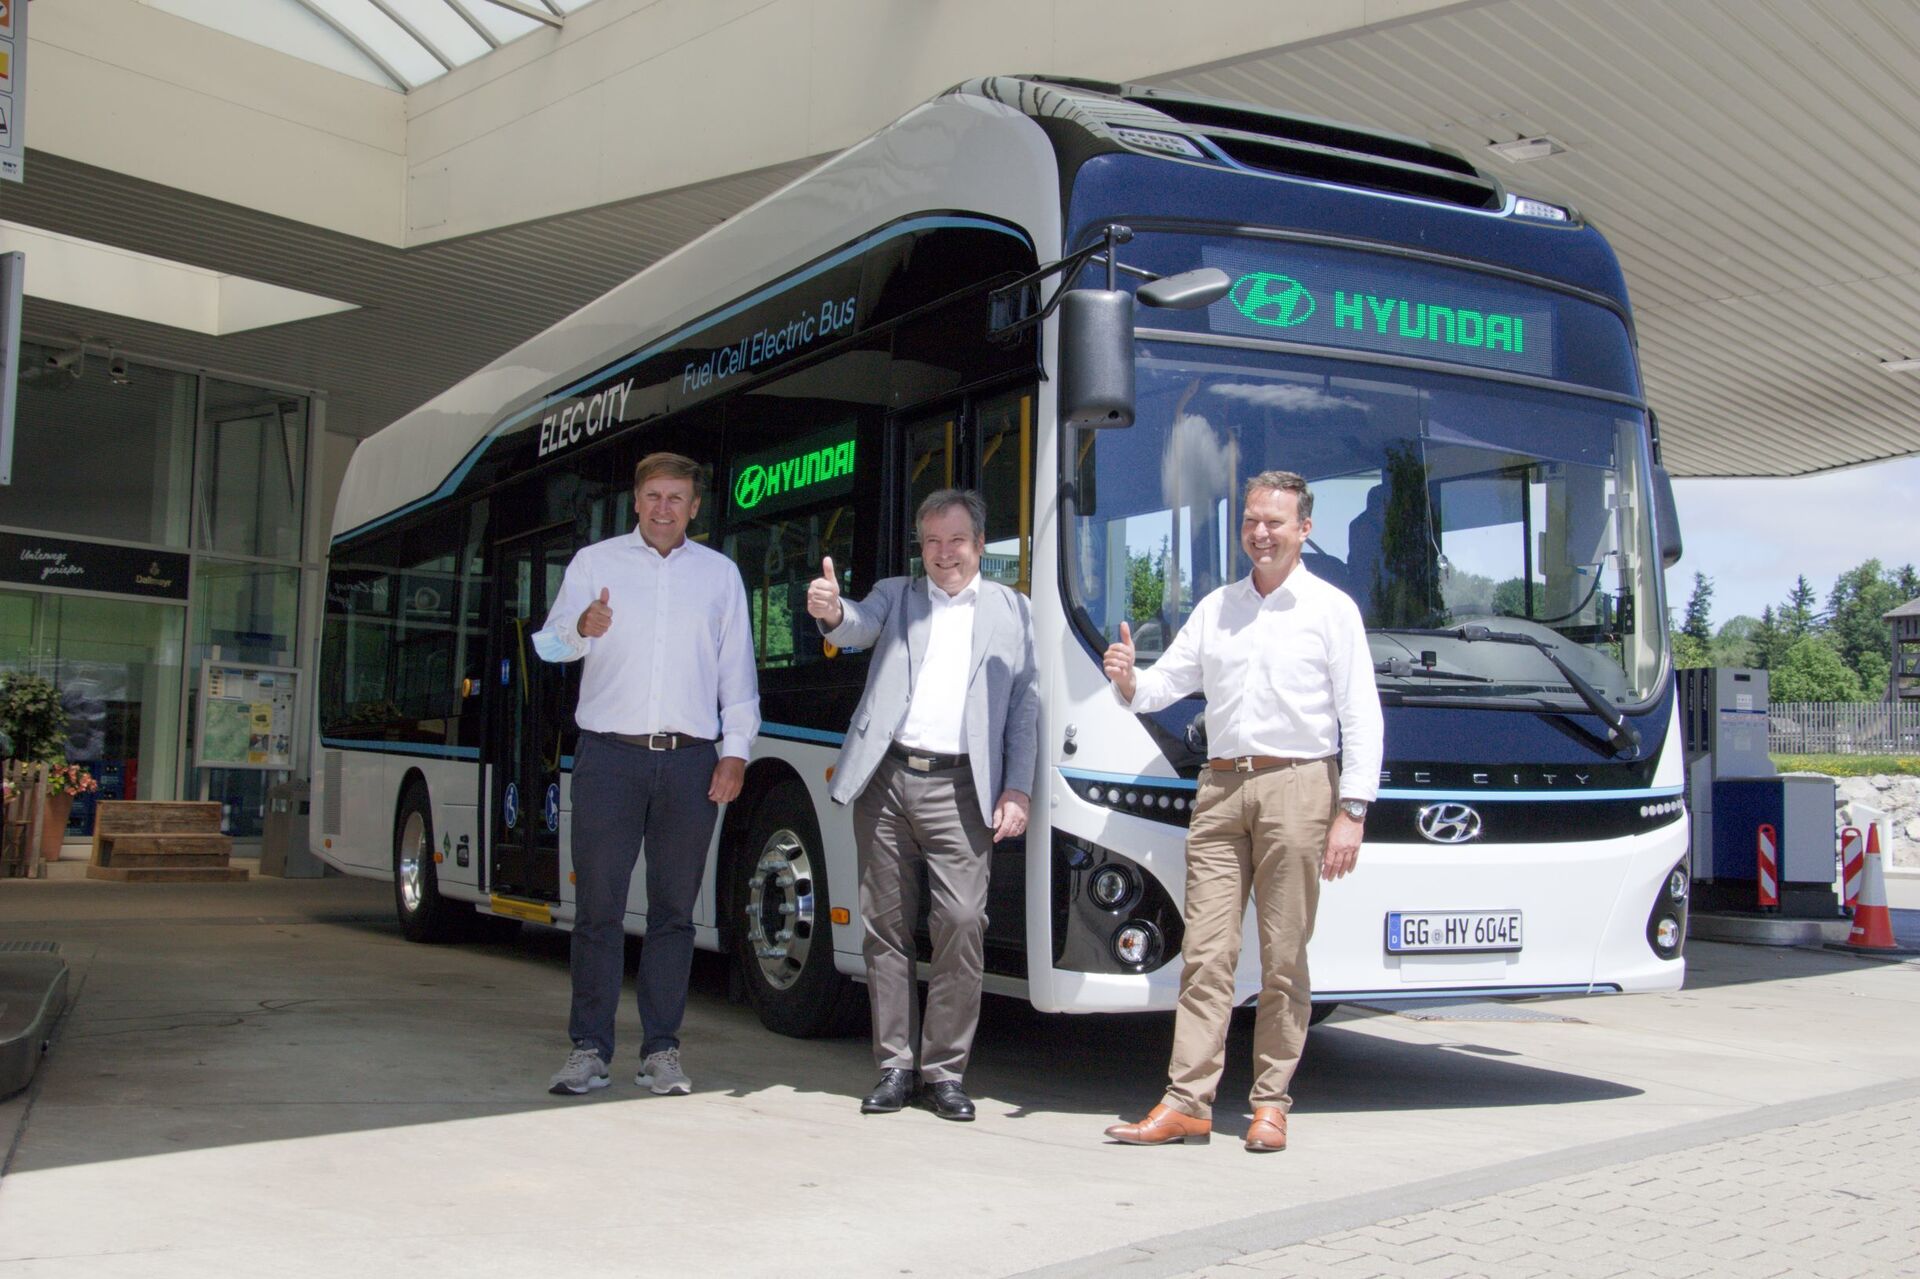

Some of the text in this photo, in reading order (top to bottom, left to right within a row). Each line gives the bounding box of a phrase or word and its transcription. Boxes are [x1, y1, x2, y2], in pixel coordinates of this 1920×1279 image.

[682, 297, 856, 394] Fuel Cell Electric Bus
[1335, 290, 1523, 353] HYUNDAI
[538, 377, 635, 456] ELEC CITY
[766, 440, 856, 496] HYUNDAI
[1379, 771, 1590, 785] EC CITY
[1403, 918, 1429, 945] GG
[1445, 918, 1469, 944] HY
[1474, 916, 1519, 943] 604E
